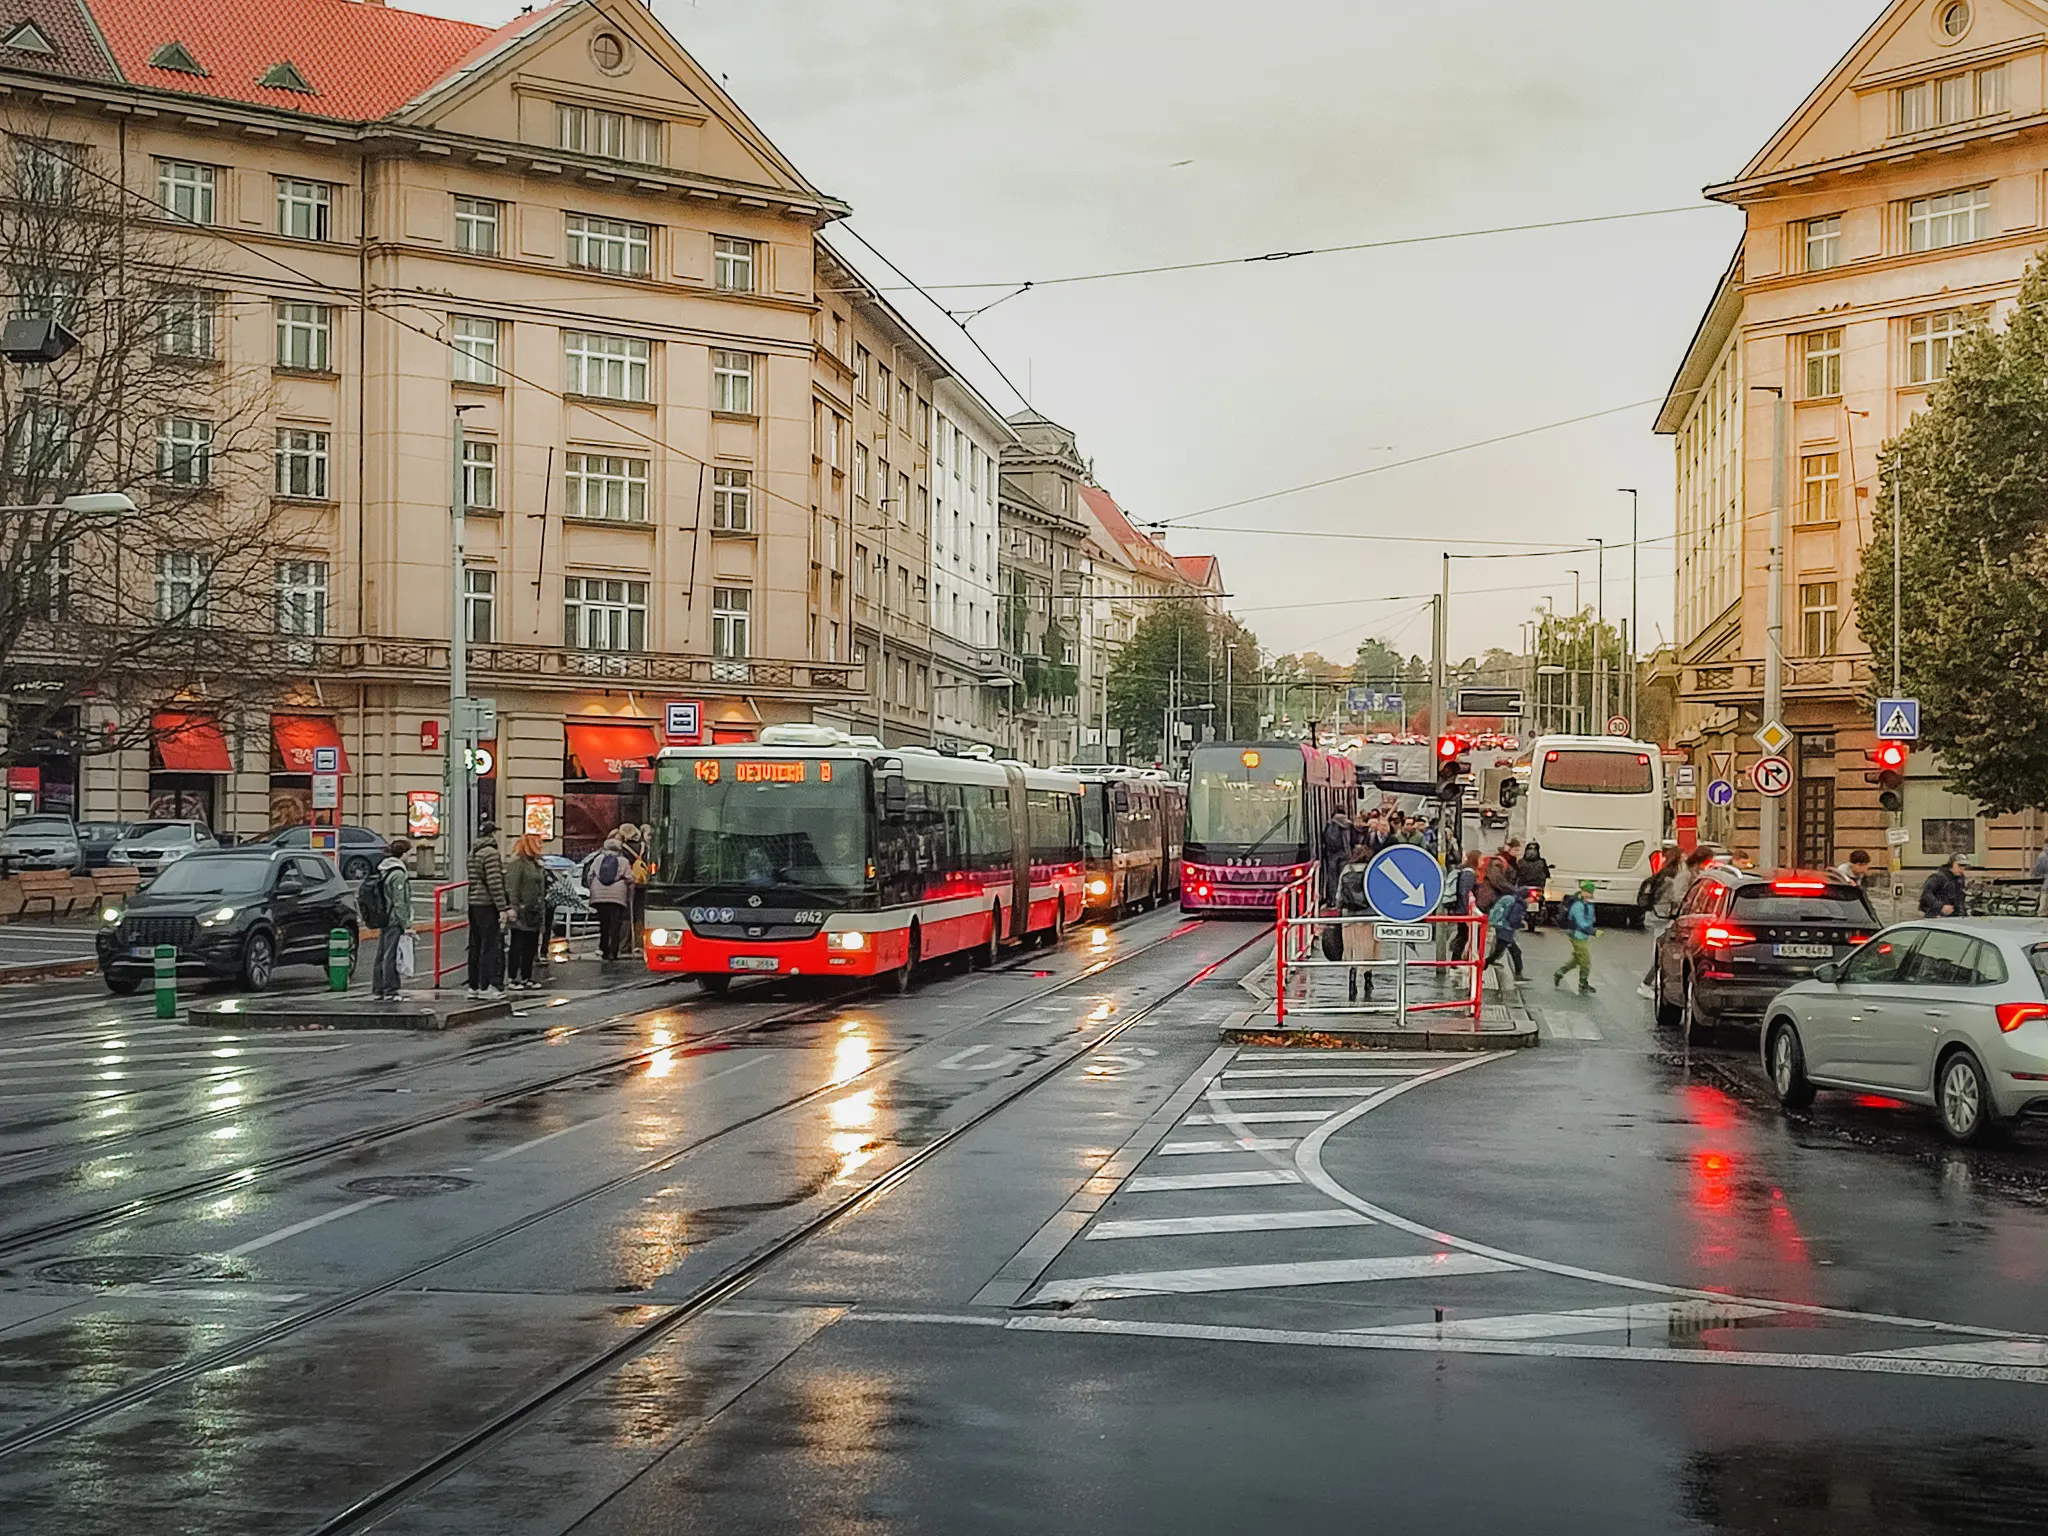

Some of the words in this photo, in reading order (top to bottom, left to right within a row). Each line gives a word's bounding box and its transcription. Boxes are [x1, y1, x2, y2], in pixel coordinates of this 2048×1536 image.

[1612, 721, 1625, 732] 30
[694, 760, 719, 782] 143
[794, 911, 822, 924] 6942
